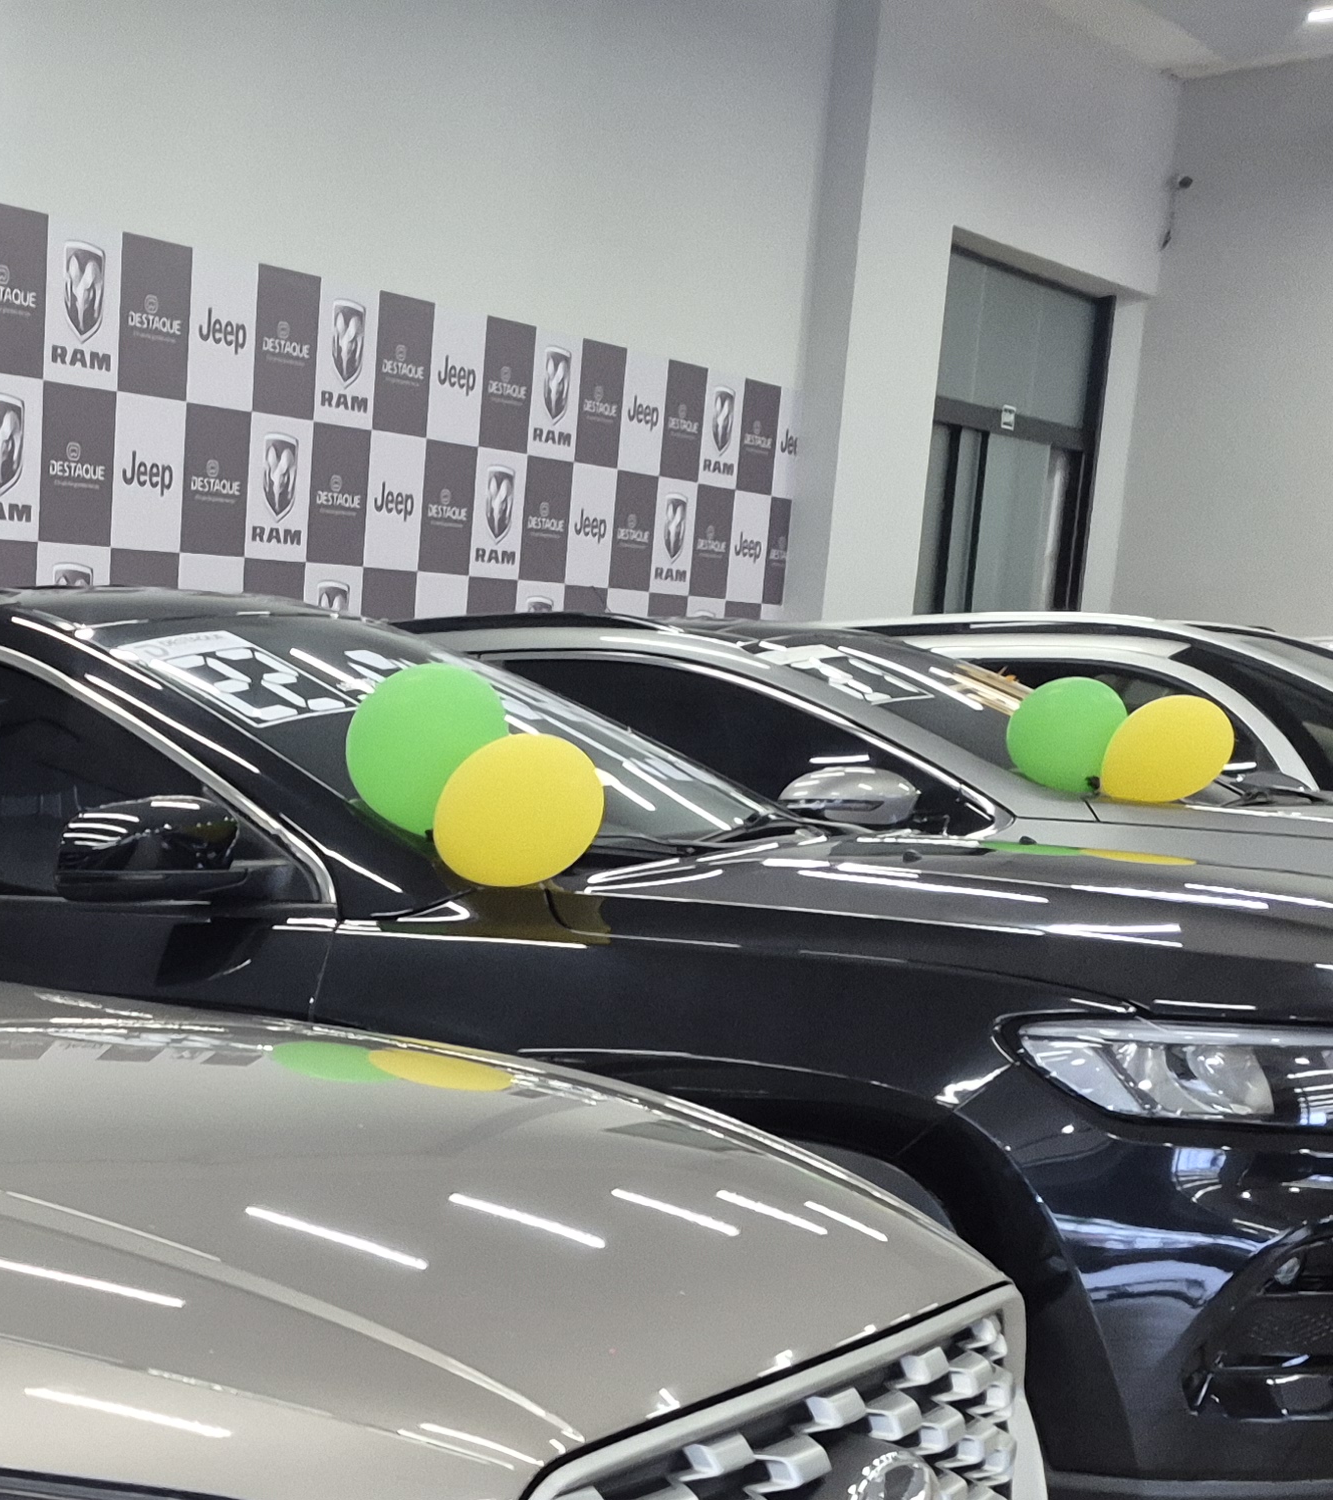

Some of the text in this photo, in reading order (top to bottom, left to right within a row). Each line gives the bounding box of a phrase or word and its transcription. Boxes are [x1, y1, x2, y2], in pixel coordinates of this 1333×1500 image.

[128, 311, 182, 335] DESTAQUE
[199, 307, 247, 355] Jeep
[51, 344, 112, 372] RAM
[262, 336, 311, 359] DESTAQUE
[382, 359, 425, 380] DESTAQUE
[438, 354, 476, 397] Jeep
[487, 379, 527, 400] DESTAQUE
[320, 390, 369, 414] RAM
[583, 398, 618, 418] DESTAQUE
[628, 395, 659, 432] Jeep
[533, 427, 572, 447] RAM
[49, 460, 105, 480] DESTAQUE
[122, 450, 173, 497] Jeep
[703, 458, 735, 477] RAM
[190, 476, 241, 495] DESTAQUE
[316, 490, 361, 508] DESTAQUE
[374, 481, 414, 522] Jeep
[428, 503, 468, 521] DESTAQUE
[527, 516, 564, 532] DESTAQUE
[574, 508, 607, 544] Jeep
[251, 525, 302, 545] RAM
[474, 547, 517, 566] RAM
[734, 531, 762, 564] Jeep
[654, 567, 687, 582] RAM
[166, 647, 346, 721] 22
